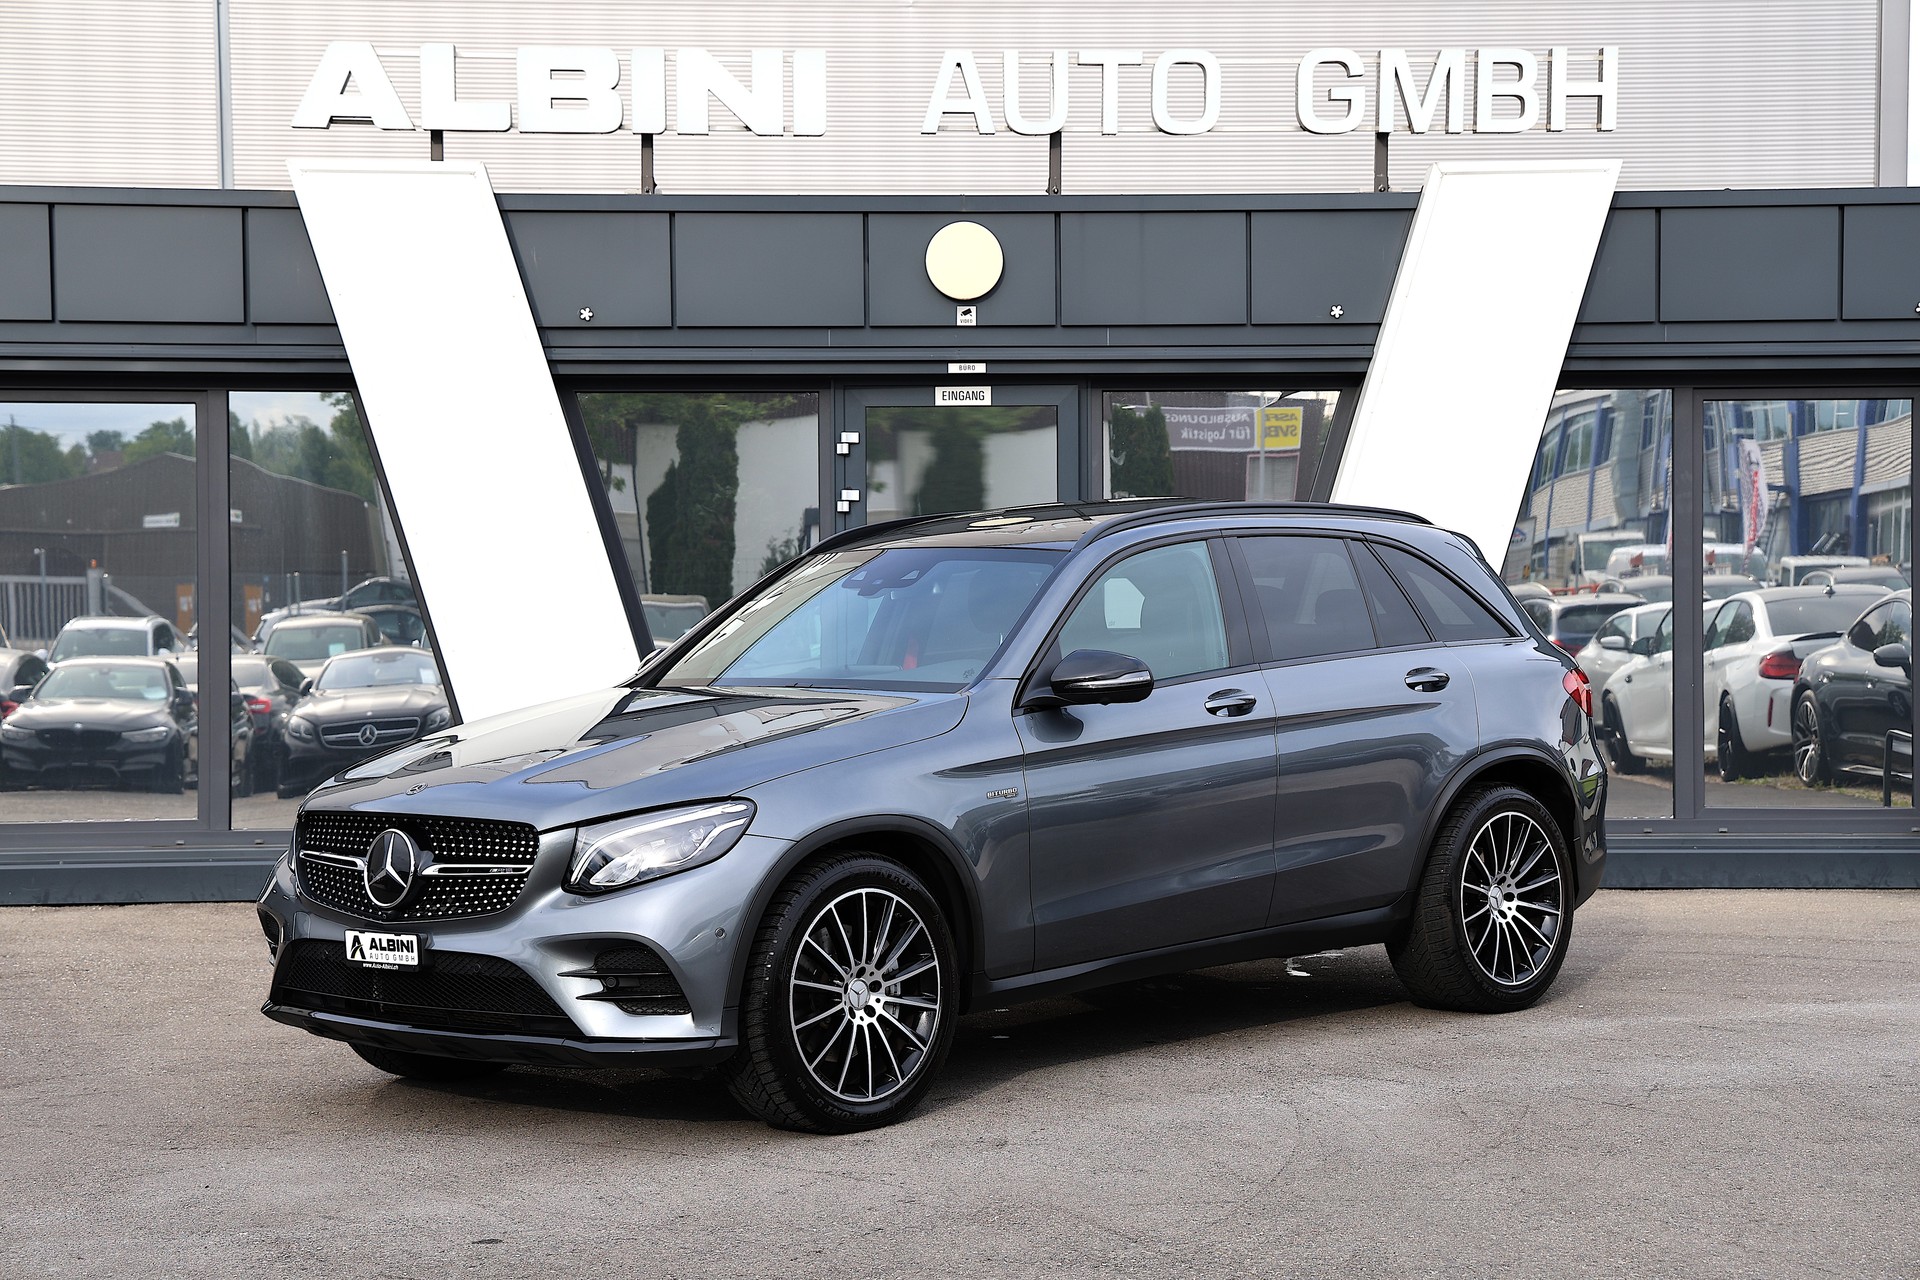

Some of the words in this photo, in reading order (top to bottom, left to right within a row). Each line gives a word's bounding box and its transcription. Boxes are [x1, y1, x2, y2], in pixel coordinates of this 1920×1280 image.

[291, 41, 827, 136] ALBINI
[921, 47, 1221, 136] AUTO
[1296, 46, 1619, 135] GMBH
[942, 390, 985, 401] EINGANG
[369, 938, 414, 953] ALBINI
[369, 953, 390, 961] AUTO
[392, 953, 416, 962] GMBH
